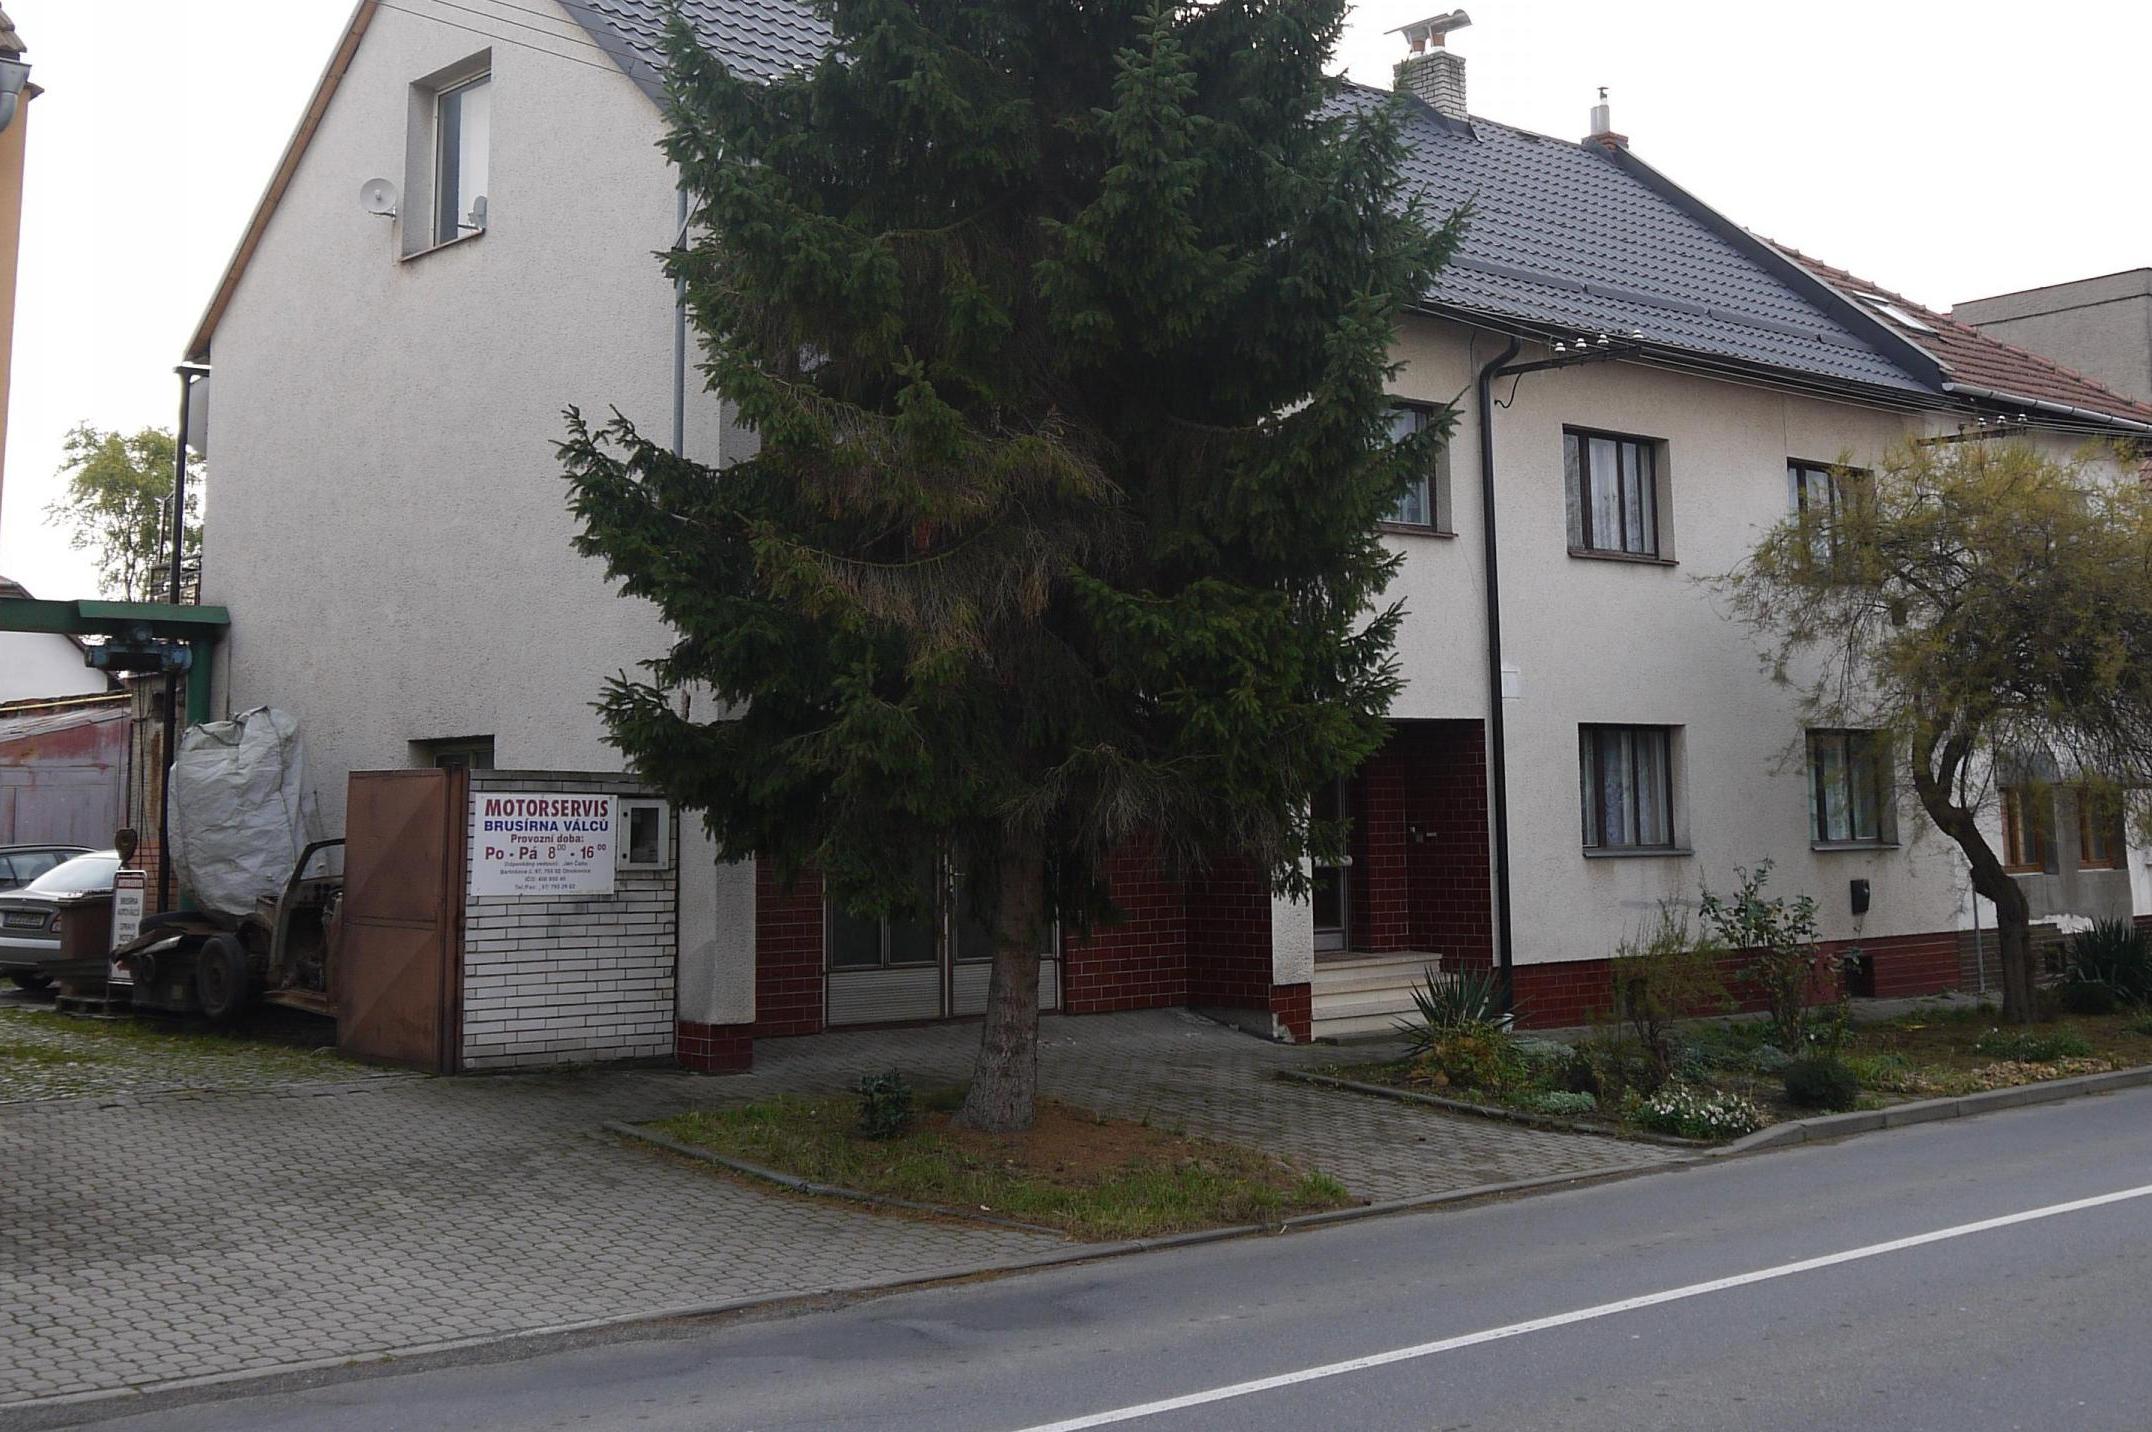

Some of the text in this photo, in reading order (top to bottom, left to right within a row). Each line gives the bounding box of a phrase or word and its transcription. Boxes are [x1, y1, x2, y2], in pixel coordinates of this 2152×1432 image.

[484, 799, 609, 817] MOTORSERVIS
[484, 818, 609, 832] BRUSÍRNA VÁLCŮ
[510, 834, 585, 844] Provozní doba:
[485, 846, 505, 860] Po
[519, 845, 538, 860] Pá
